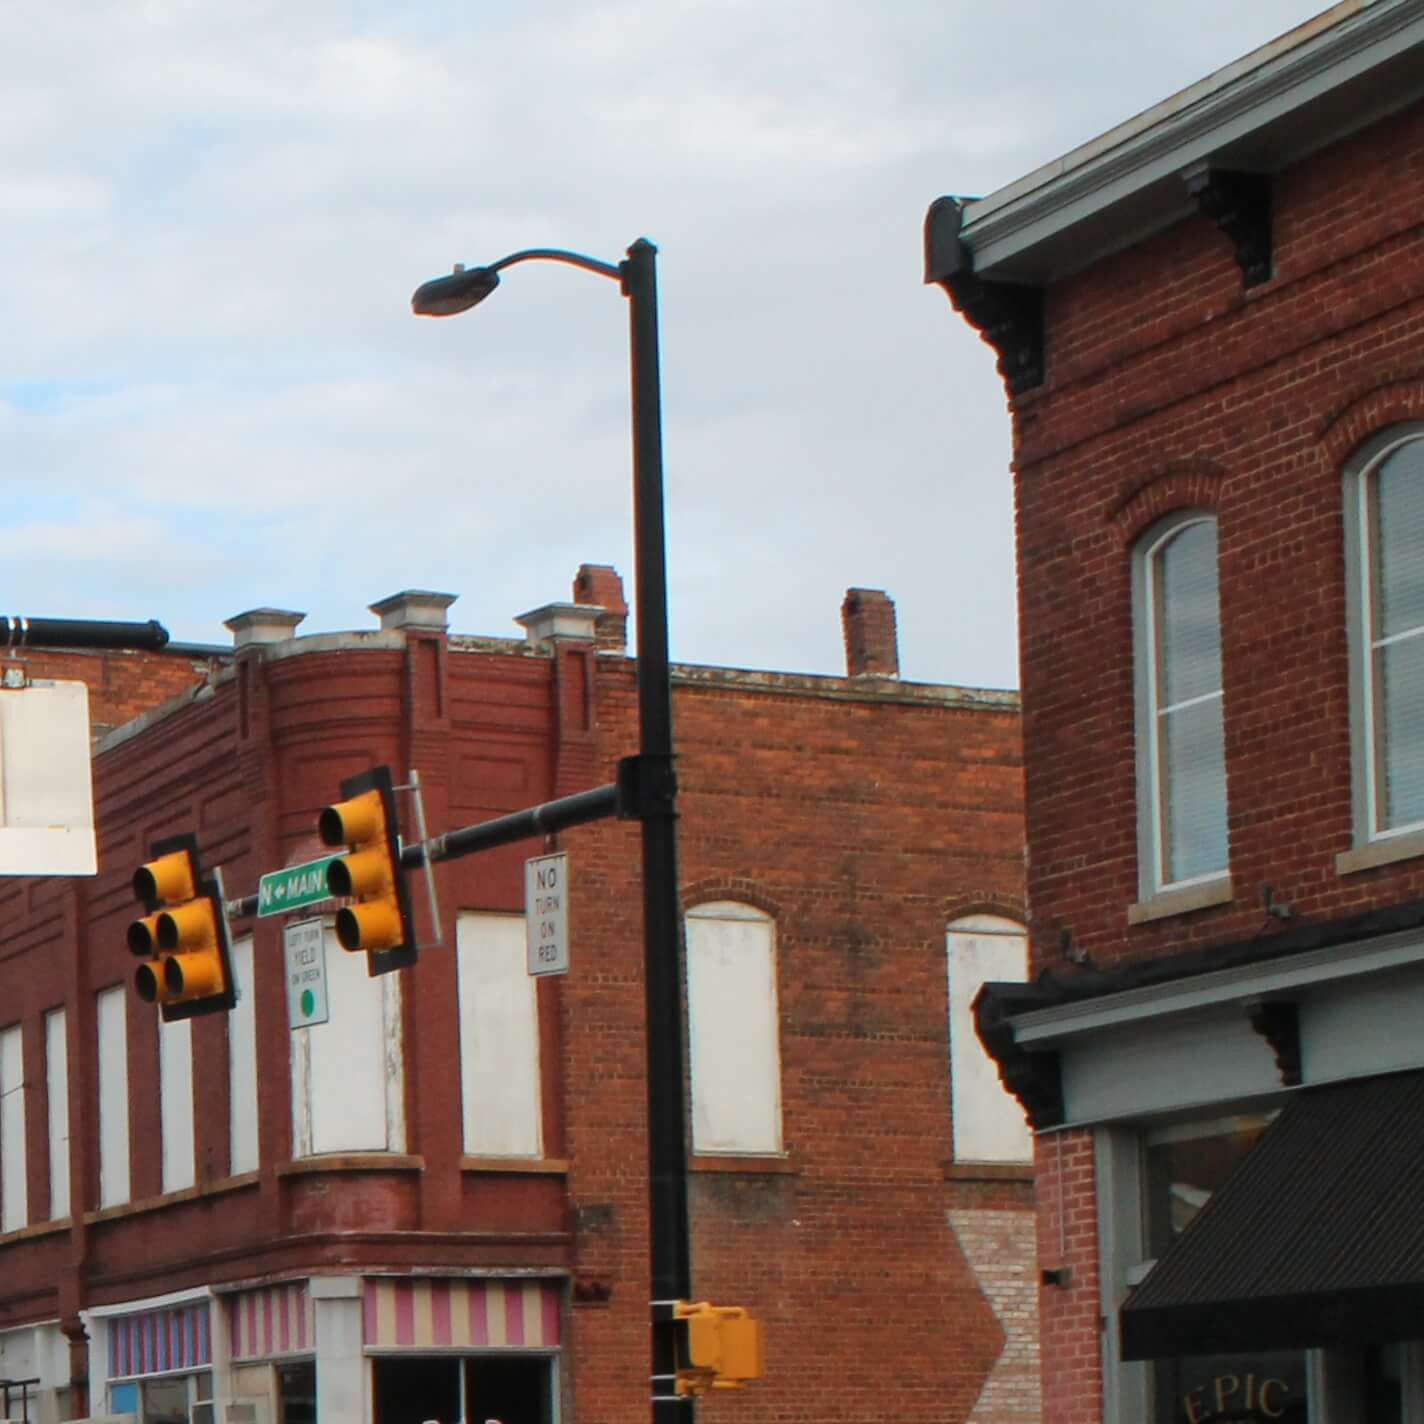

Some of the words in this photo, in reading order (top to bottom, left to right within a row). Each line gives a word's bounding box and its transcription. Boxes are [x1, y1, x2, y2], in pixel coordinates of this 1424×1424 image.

[262, 884, 272, 905] N
[287, 868, 322, 899] MAIN
[537, 868, 556, 888] NO
[536, 896, 559, 915] TURN
[304, 928, 319, 943] TURN
[541, 921, 555, 938] ON
[294, 948, 315, 965] YIELD
[539, 944, 557, 962] RED
[1183, 1373, 1289, 1424] EPIC
